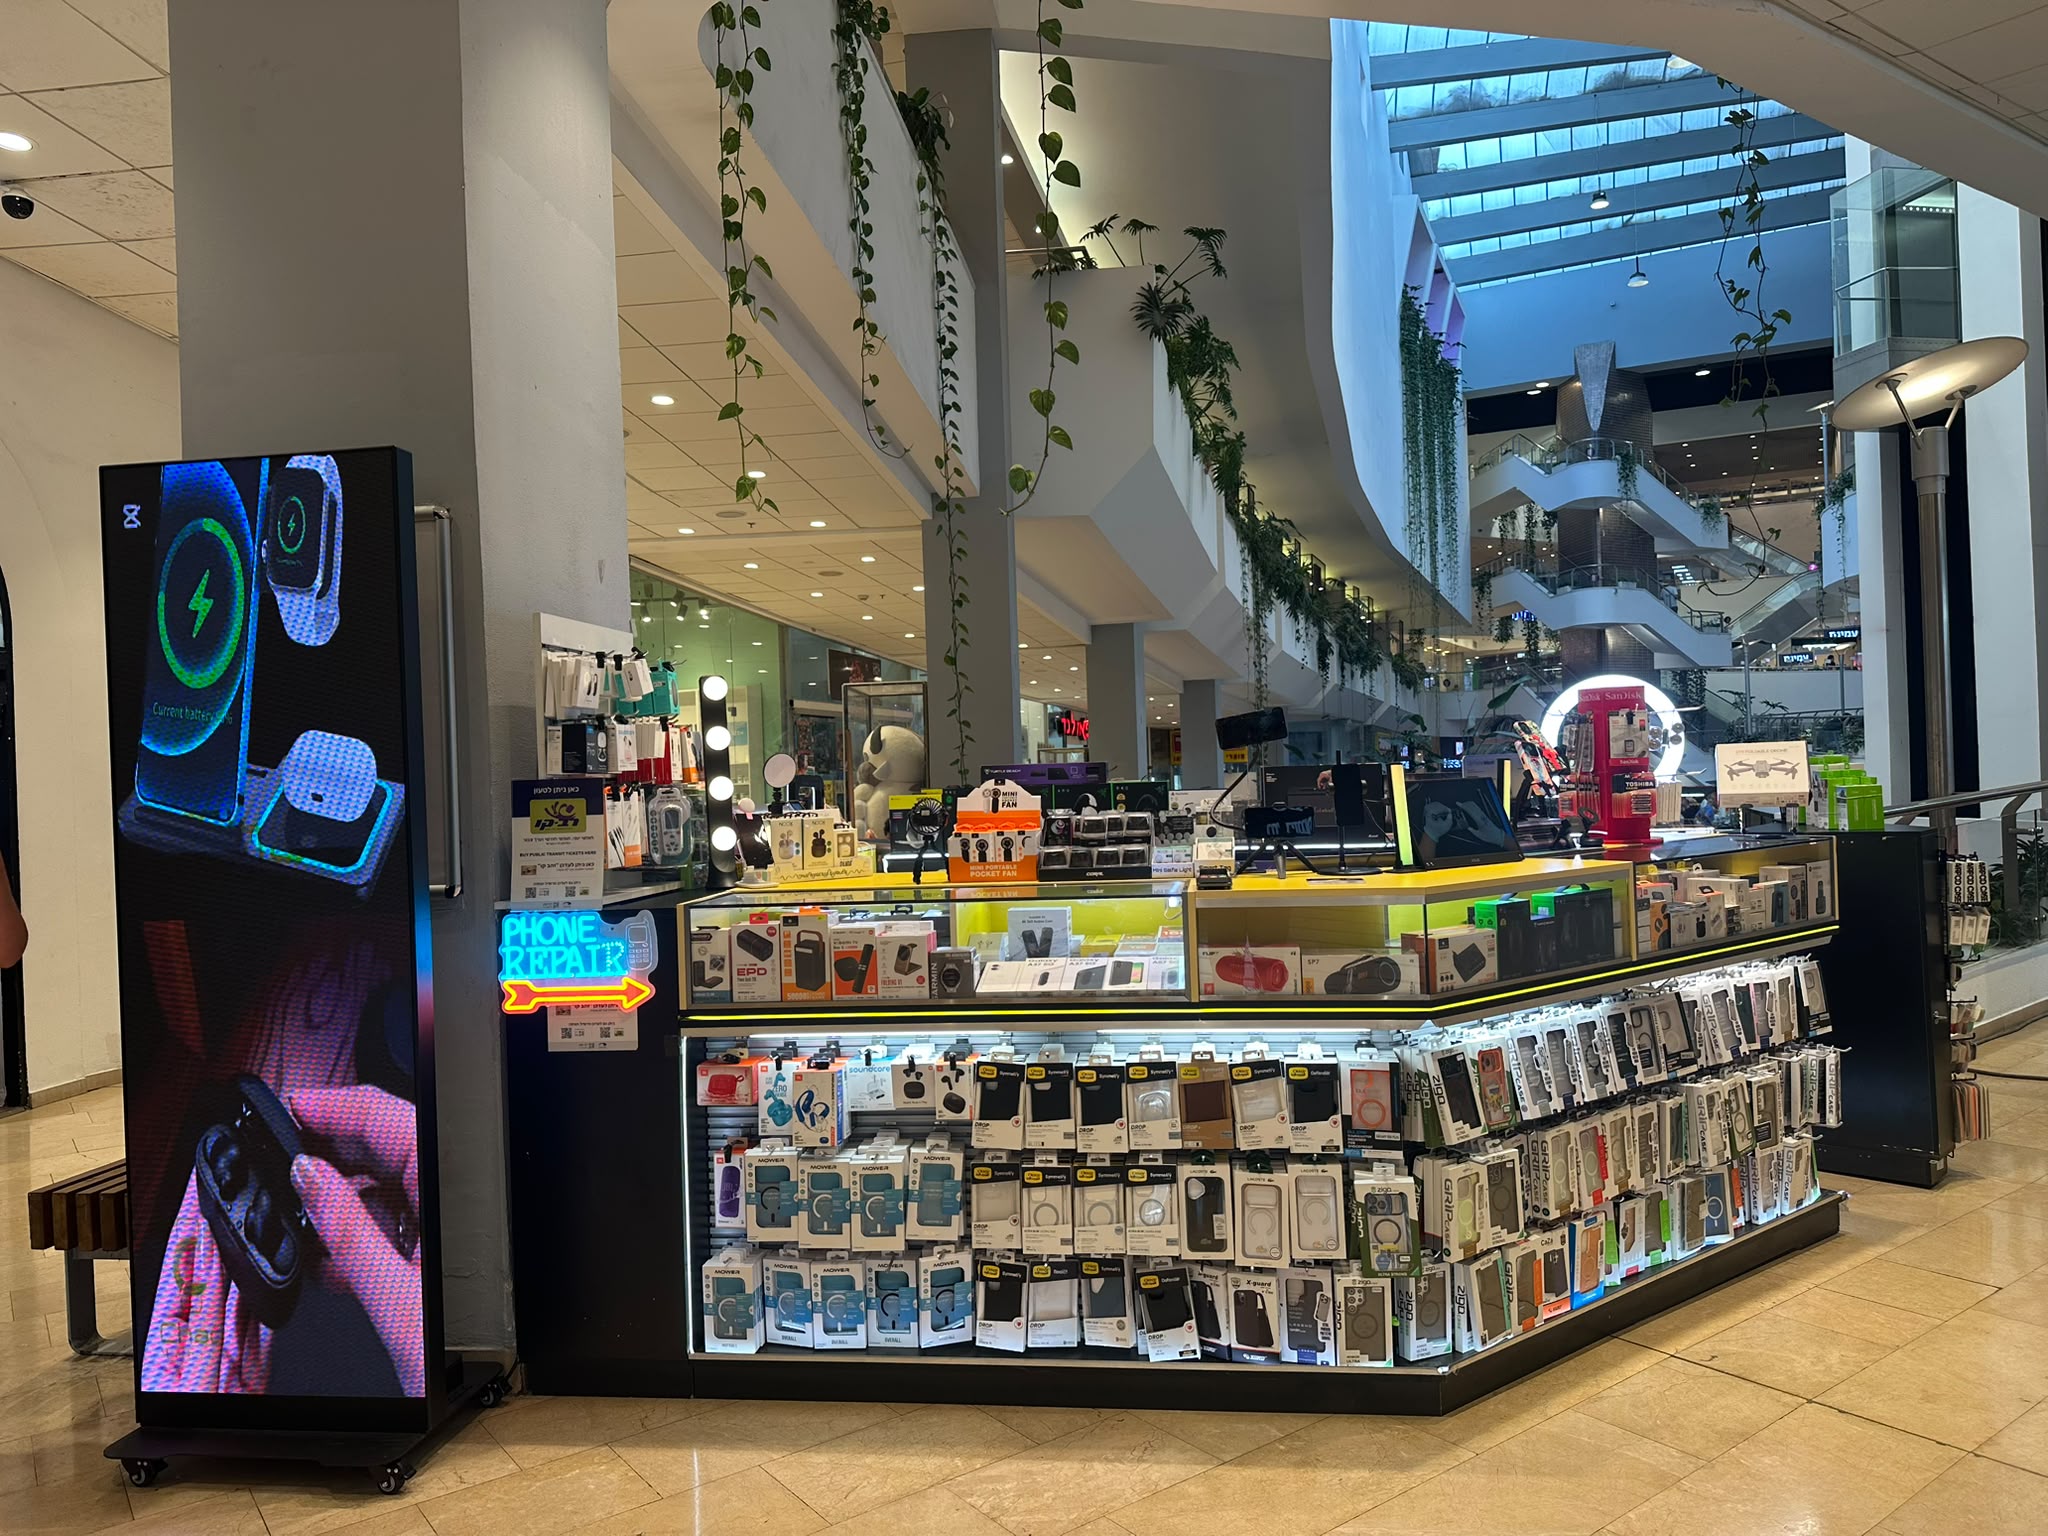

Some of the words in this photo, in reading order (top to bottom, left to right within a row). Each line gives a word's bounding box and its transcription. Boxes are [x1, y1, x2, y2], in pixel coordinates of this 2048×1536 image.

[1605, 691, 1642, 701] SanDisk
[152, 702, 183, 719] Current
[533, 787, 552, 795] לטעון
[553, 786, 567, 794] ניתן
[568, 786, 580, 794] כאן
[1002, 869, 1017, 877] FAN
[503, 915, 598, 946] PHONE
[500, 941, 629, 980] REPAIR
[737, 968, 768, 976] EPD
[849, 1065, 890, 1073] soundcore
[1420, 1078, 1432, 1109] zigo
[1432, 1074, 1446, 1105] zigo
[1377, 1186, 1392, 1194] zigo
[1246, 1279, 1272, 1287] X-guard
[1456, 1285, 1465, 1315] zigo
[1404, 1291, 1414, 1321] zigo
